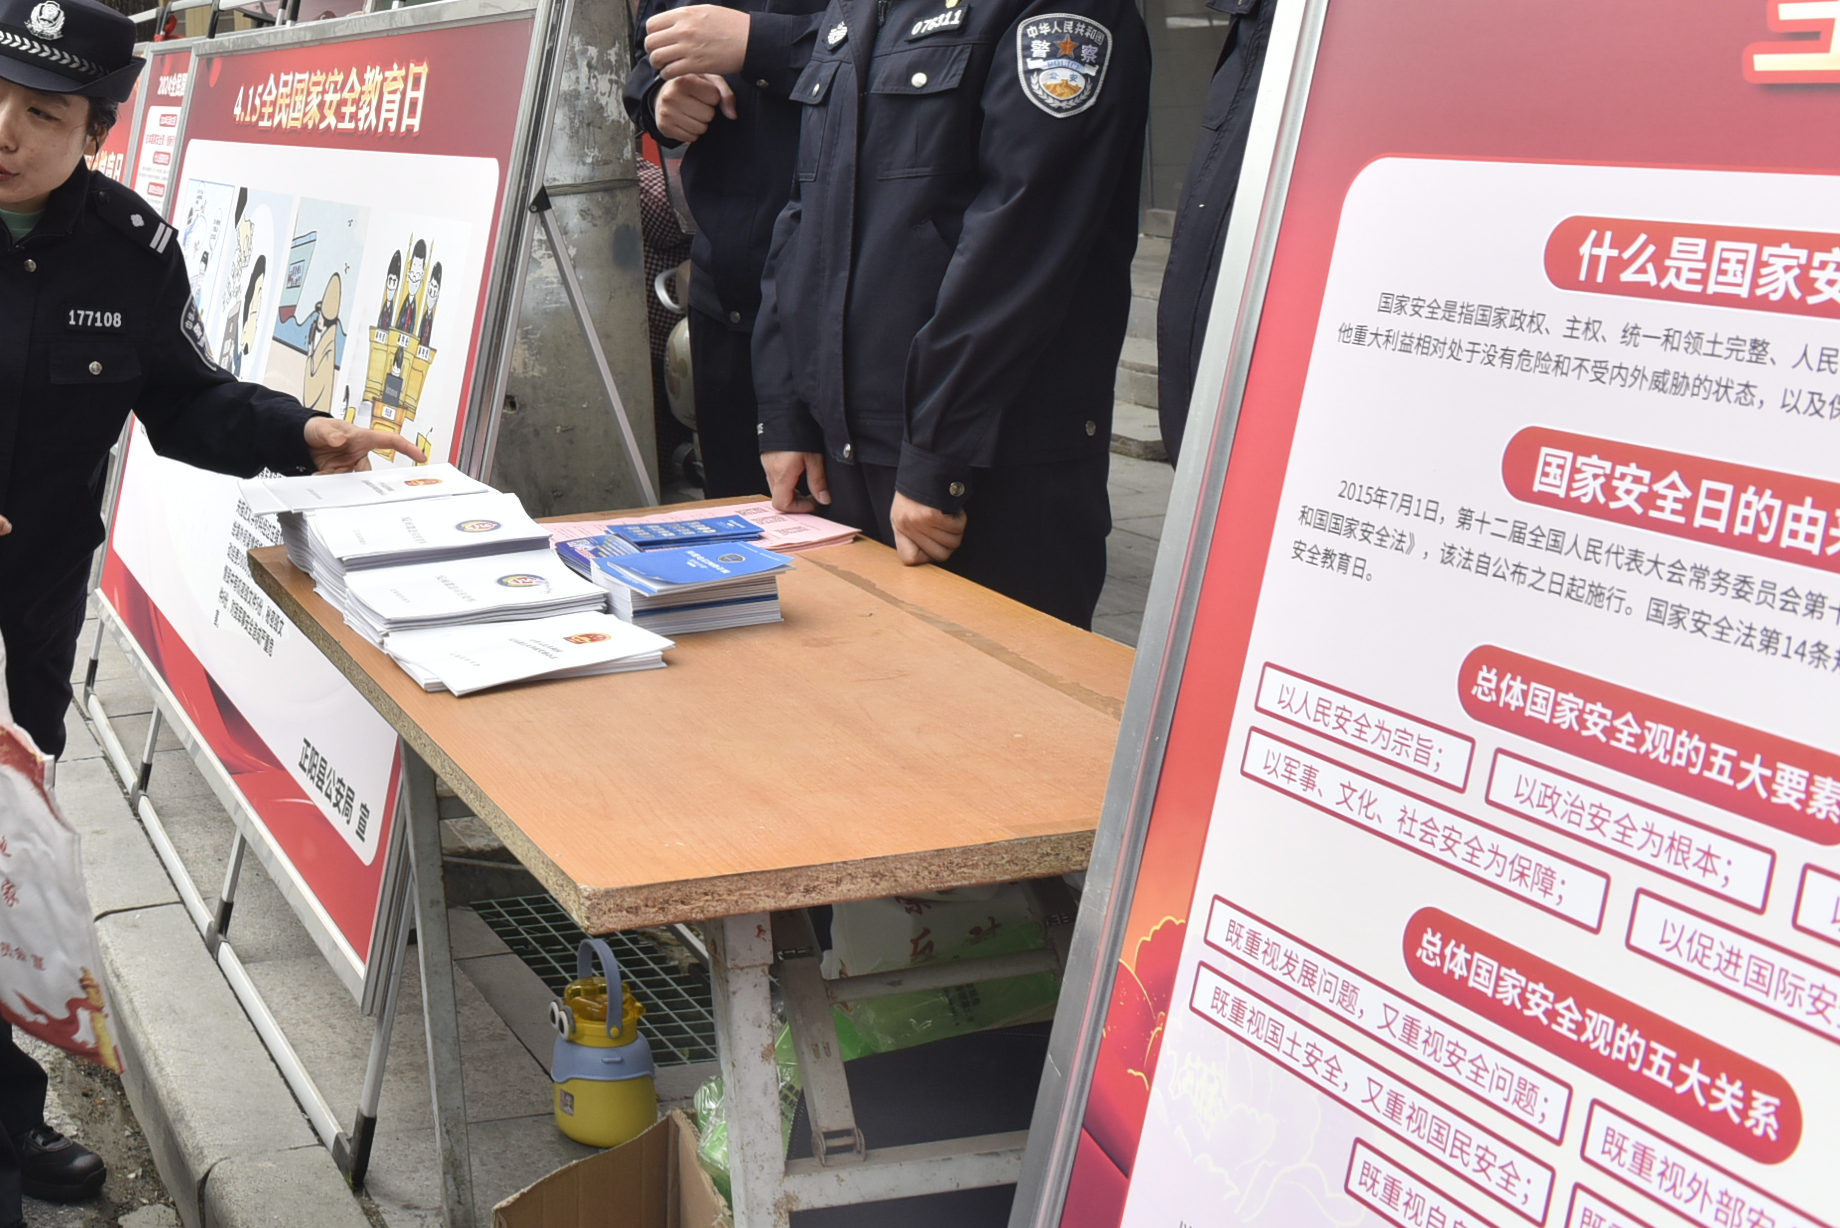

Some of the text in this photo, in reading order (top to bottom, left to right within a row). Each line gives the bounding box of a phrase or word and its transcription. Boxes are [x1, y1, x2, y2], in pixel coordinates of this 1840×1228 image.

[910, 9, 963, 36] 076311
[1026, 20, 1106, 46] 中华人民共和国
[233, 62, 430, 135] 4.15全民国家安全教育日
[68, 309, 122, 328] 177108
[1579, 229, 1840, 306] 什么是国家安
[1291, 539, 1374, 584] 安全教育日。
[1277, 683, 1443, 774] 以人民安全为宗旨；
[1470, 665, 1840, 824] 总体国家安全观的五大要素
[298, 737, 371, 844] 正阳县公安局 宣
[1264, 748, 1566, 907] 以军事、文化、社会安全为保障；
[1514, 773, 1733, 890] 以政治安全为根本；
[1224, 917, 1551, 1125] 既重视发展问题，又重视安全问题；
[1658, 918, 1840, 1028] 以促进国际安
[1416, 928, 1782, 1143] 总体国家安全观的五大关系
[1209, 984, 1534, 1206] 既重视国土安全，又重视国民安全；
[1358, 1160, 1466, 1228] 既重视自
[1601, 1126, 1798, 1228] 既重视外部安
